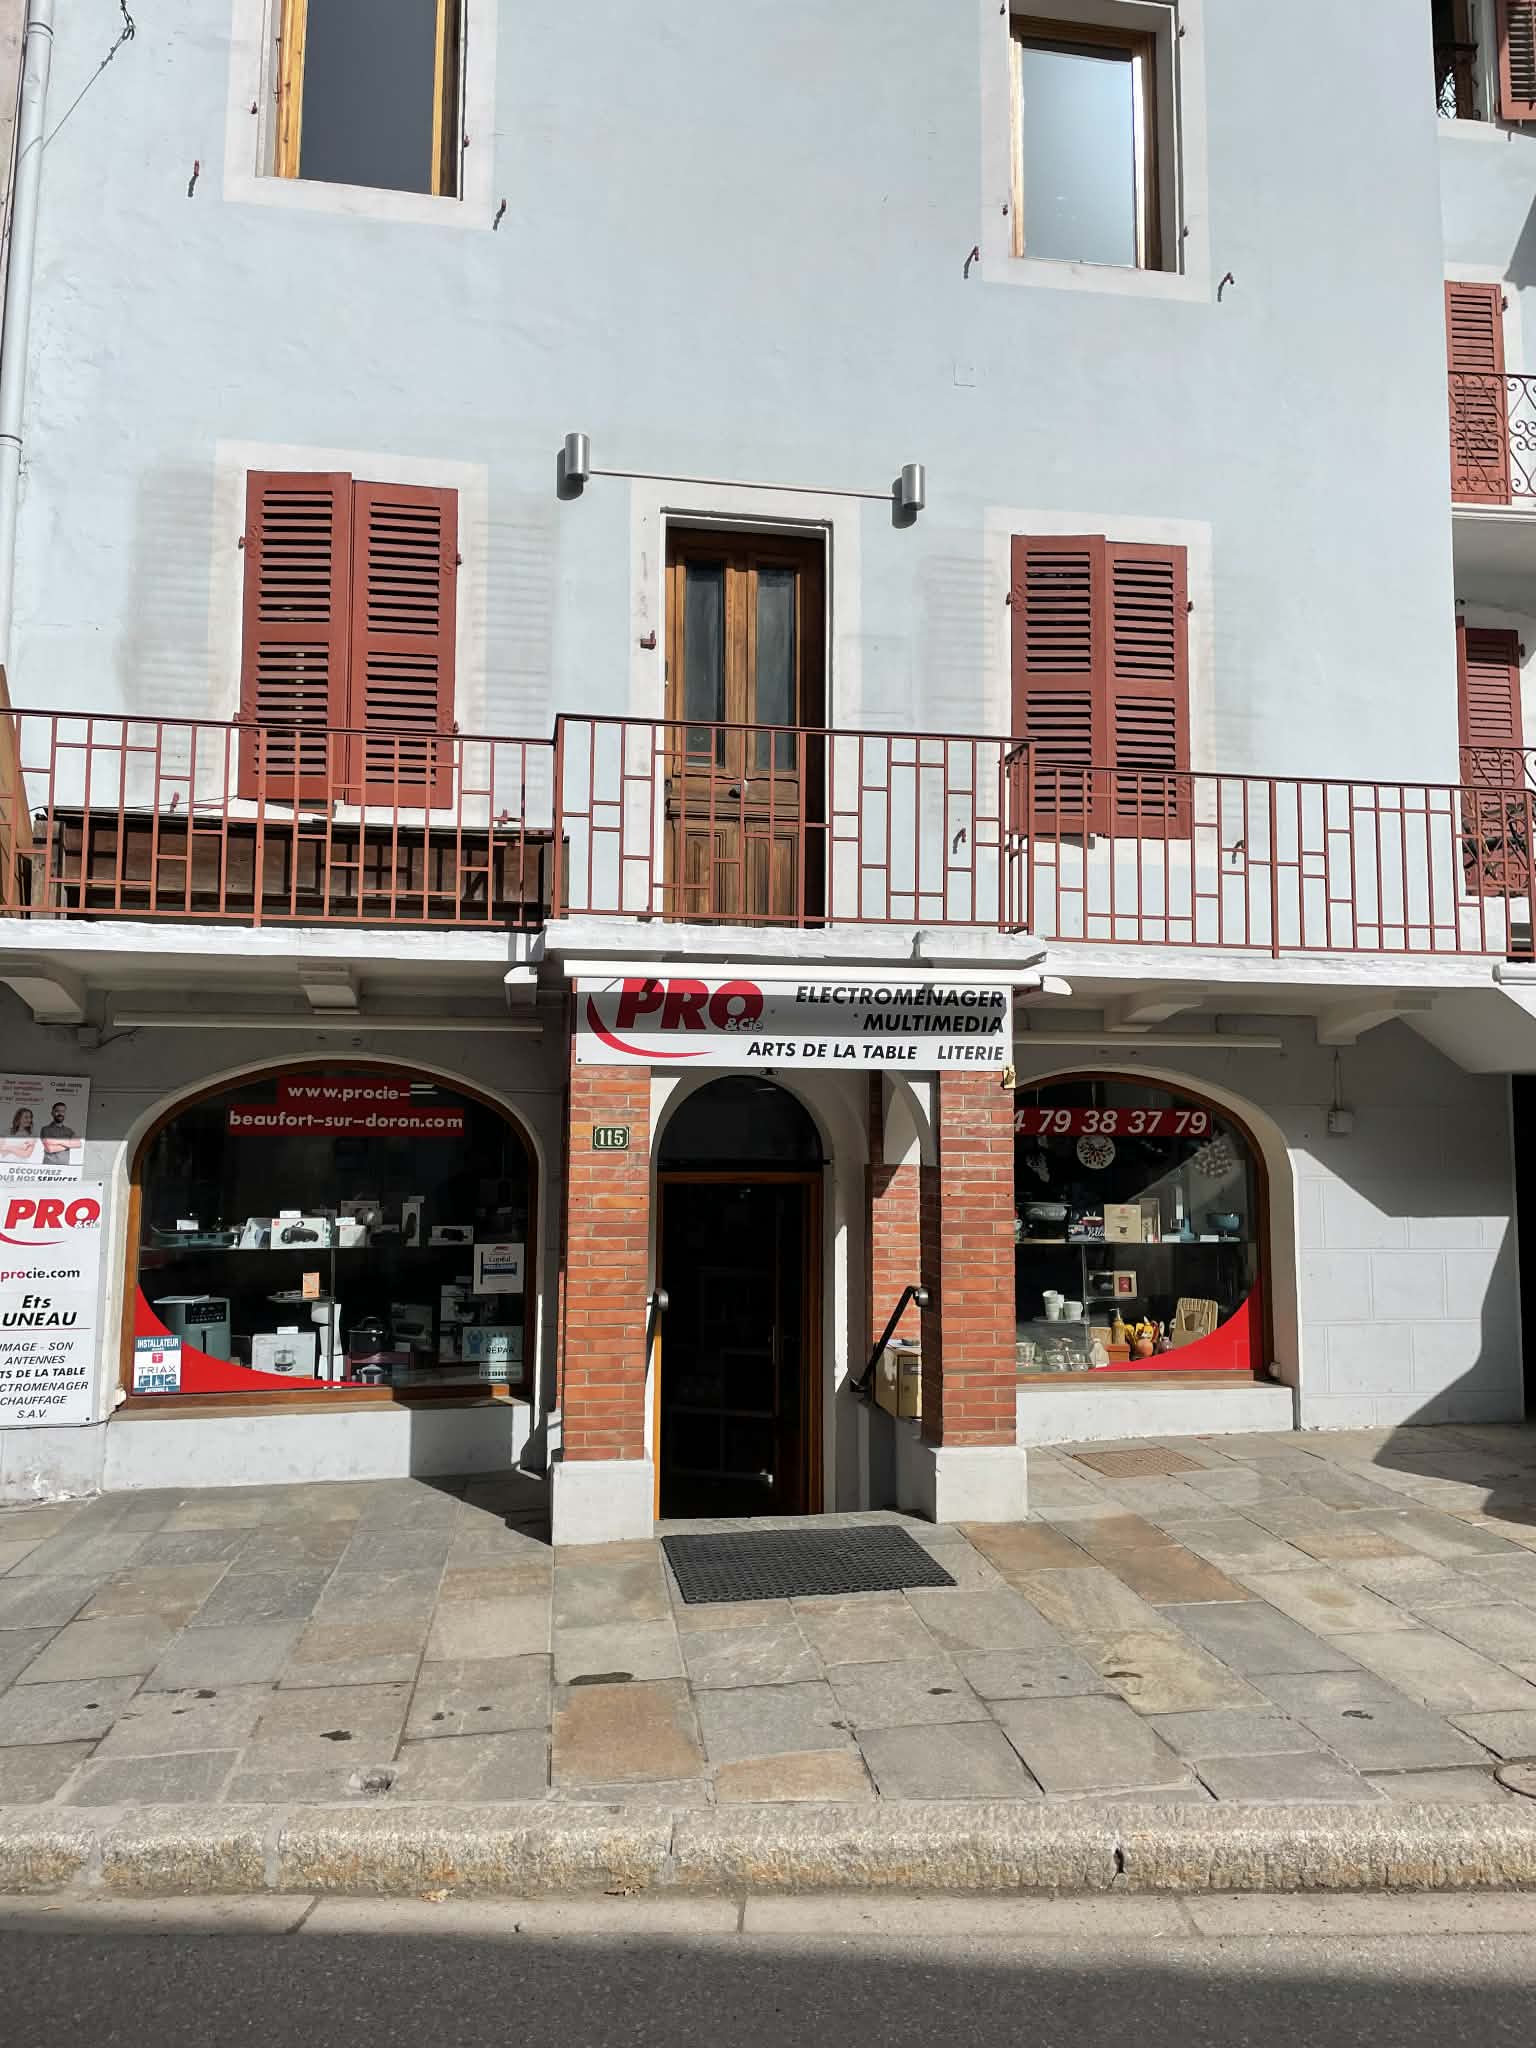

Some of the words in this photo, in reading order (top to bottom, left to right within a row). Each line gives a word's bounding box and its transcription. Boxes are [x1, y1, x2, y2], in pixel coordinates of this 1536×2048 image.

[616, 978, 764, 1031] PRO
[724, 1017, 764, 1032] &Cie
[863, 1013, 1004, 1033] MULTIMEDIA
[747, 1042, 796, 1057] ARTS
[803, 1043, 827, 1058] DE
[833, 1044, 856, 1059] LA
[863, 1045, 917, 1060] TABLE
[938, 1045, 1004, 1061] LITERIE
[230, 1111, 463, 1129] beaufort-sur-doron.com
[1038, 1110, 1071, 1133] 79
[1081, 1110, 1118, 1133] 38
[1128, 1111, 1162, 1134] 37
[1174, 1112, 1207, 1134] 79
[600, 1129, 624, 1146] 115
[4, 1198, 100, 1229] PRO
[22, 1295, 52, 1309] Ets
[2, 1312, 77, 1327] UNEAU
[48, 1342, 74, 1351] SON
[138, 1338, 179, 1348] INSTALLATEUR
[4, 1356, 66, 1365] ANTENNES
[16, 1370, 31, 1378] DE
[35, 1369, 49, 1377] LA
[53, 1367, 86, 1376] TABLE
[138, 1366, 176, 1375] TRIAX
[0, 1396, 68, 1406] CHAUFFAGE
